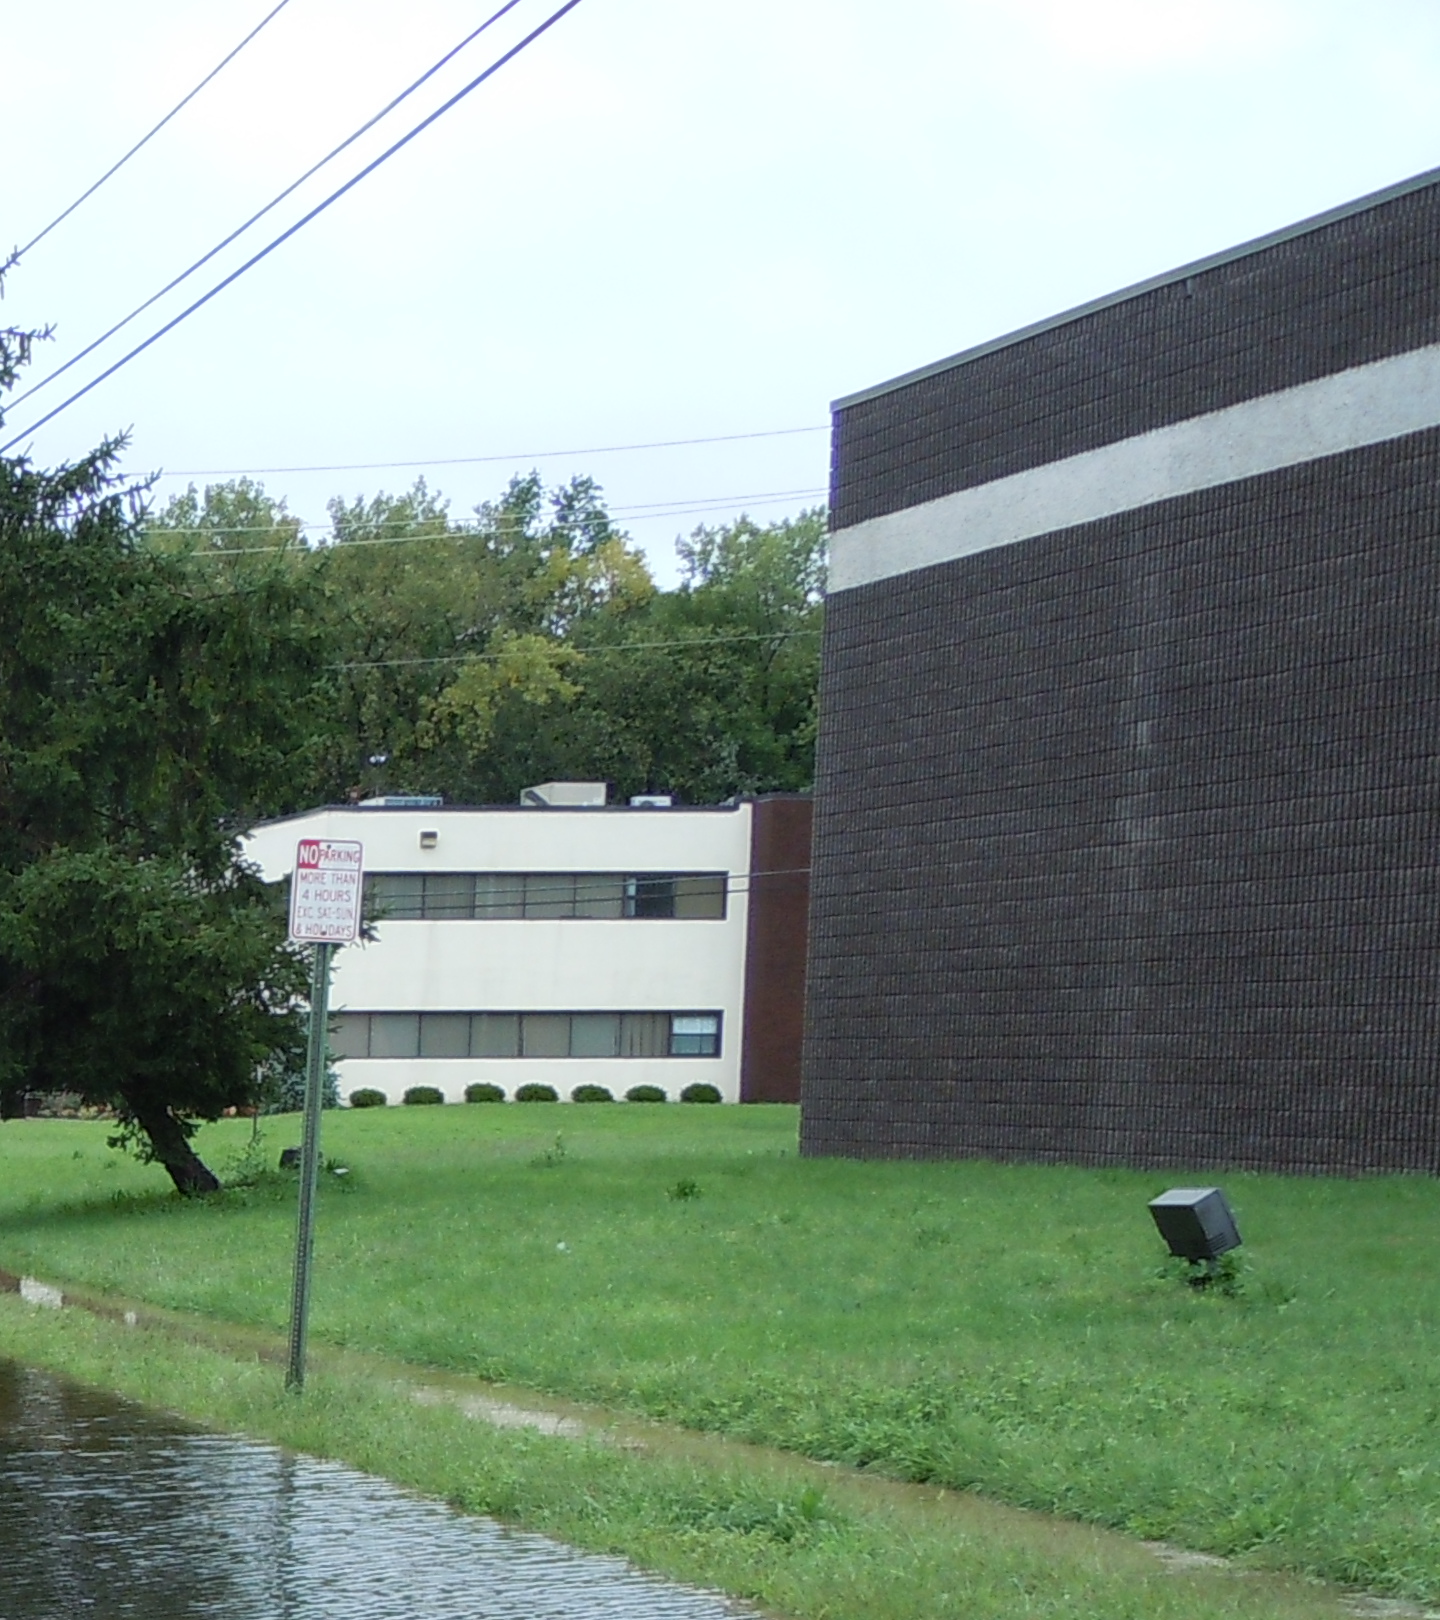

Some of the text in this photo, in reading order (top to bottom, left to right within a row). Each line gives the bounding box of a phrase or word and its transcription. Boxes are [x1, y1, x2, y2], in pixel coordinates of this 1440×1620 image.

[300, 845, 360, 864] NO PARKING
[300, 872, 356, 885] MORE THAN
[302, 890, 351, 902] 4 HOURS
[297, 907, 354, 920] EXC SAT-SUN
